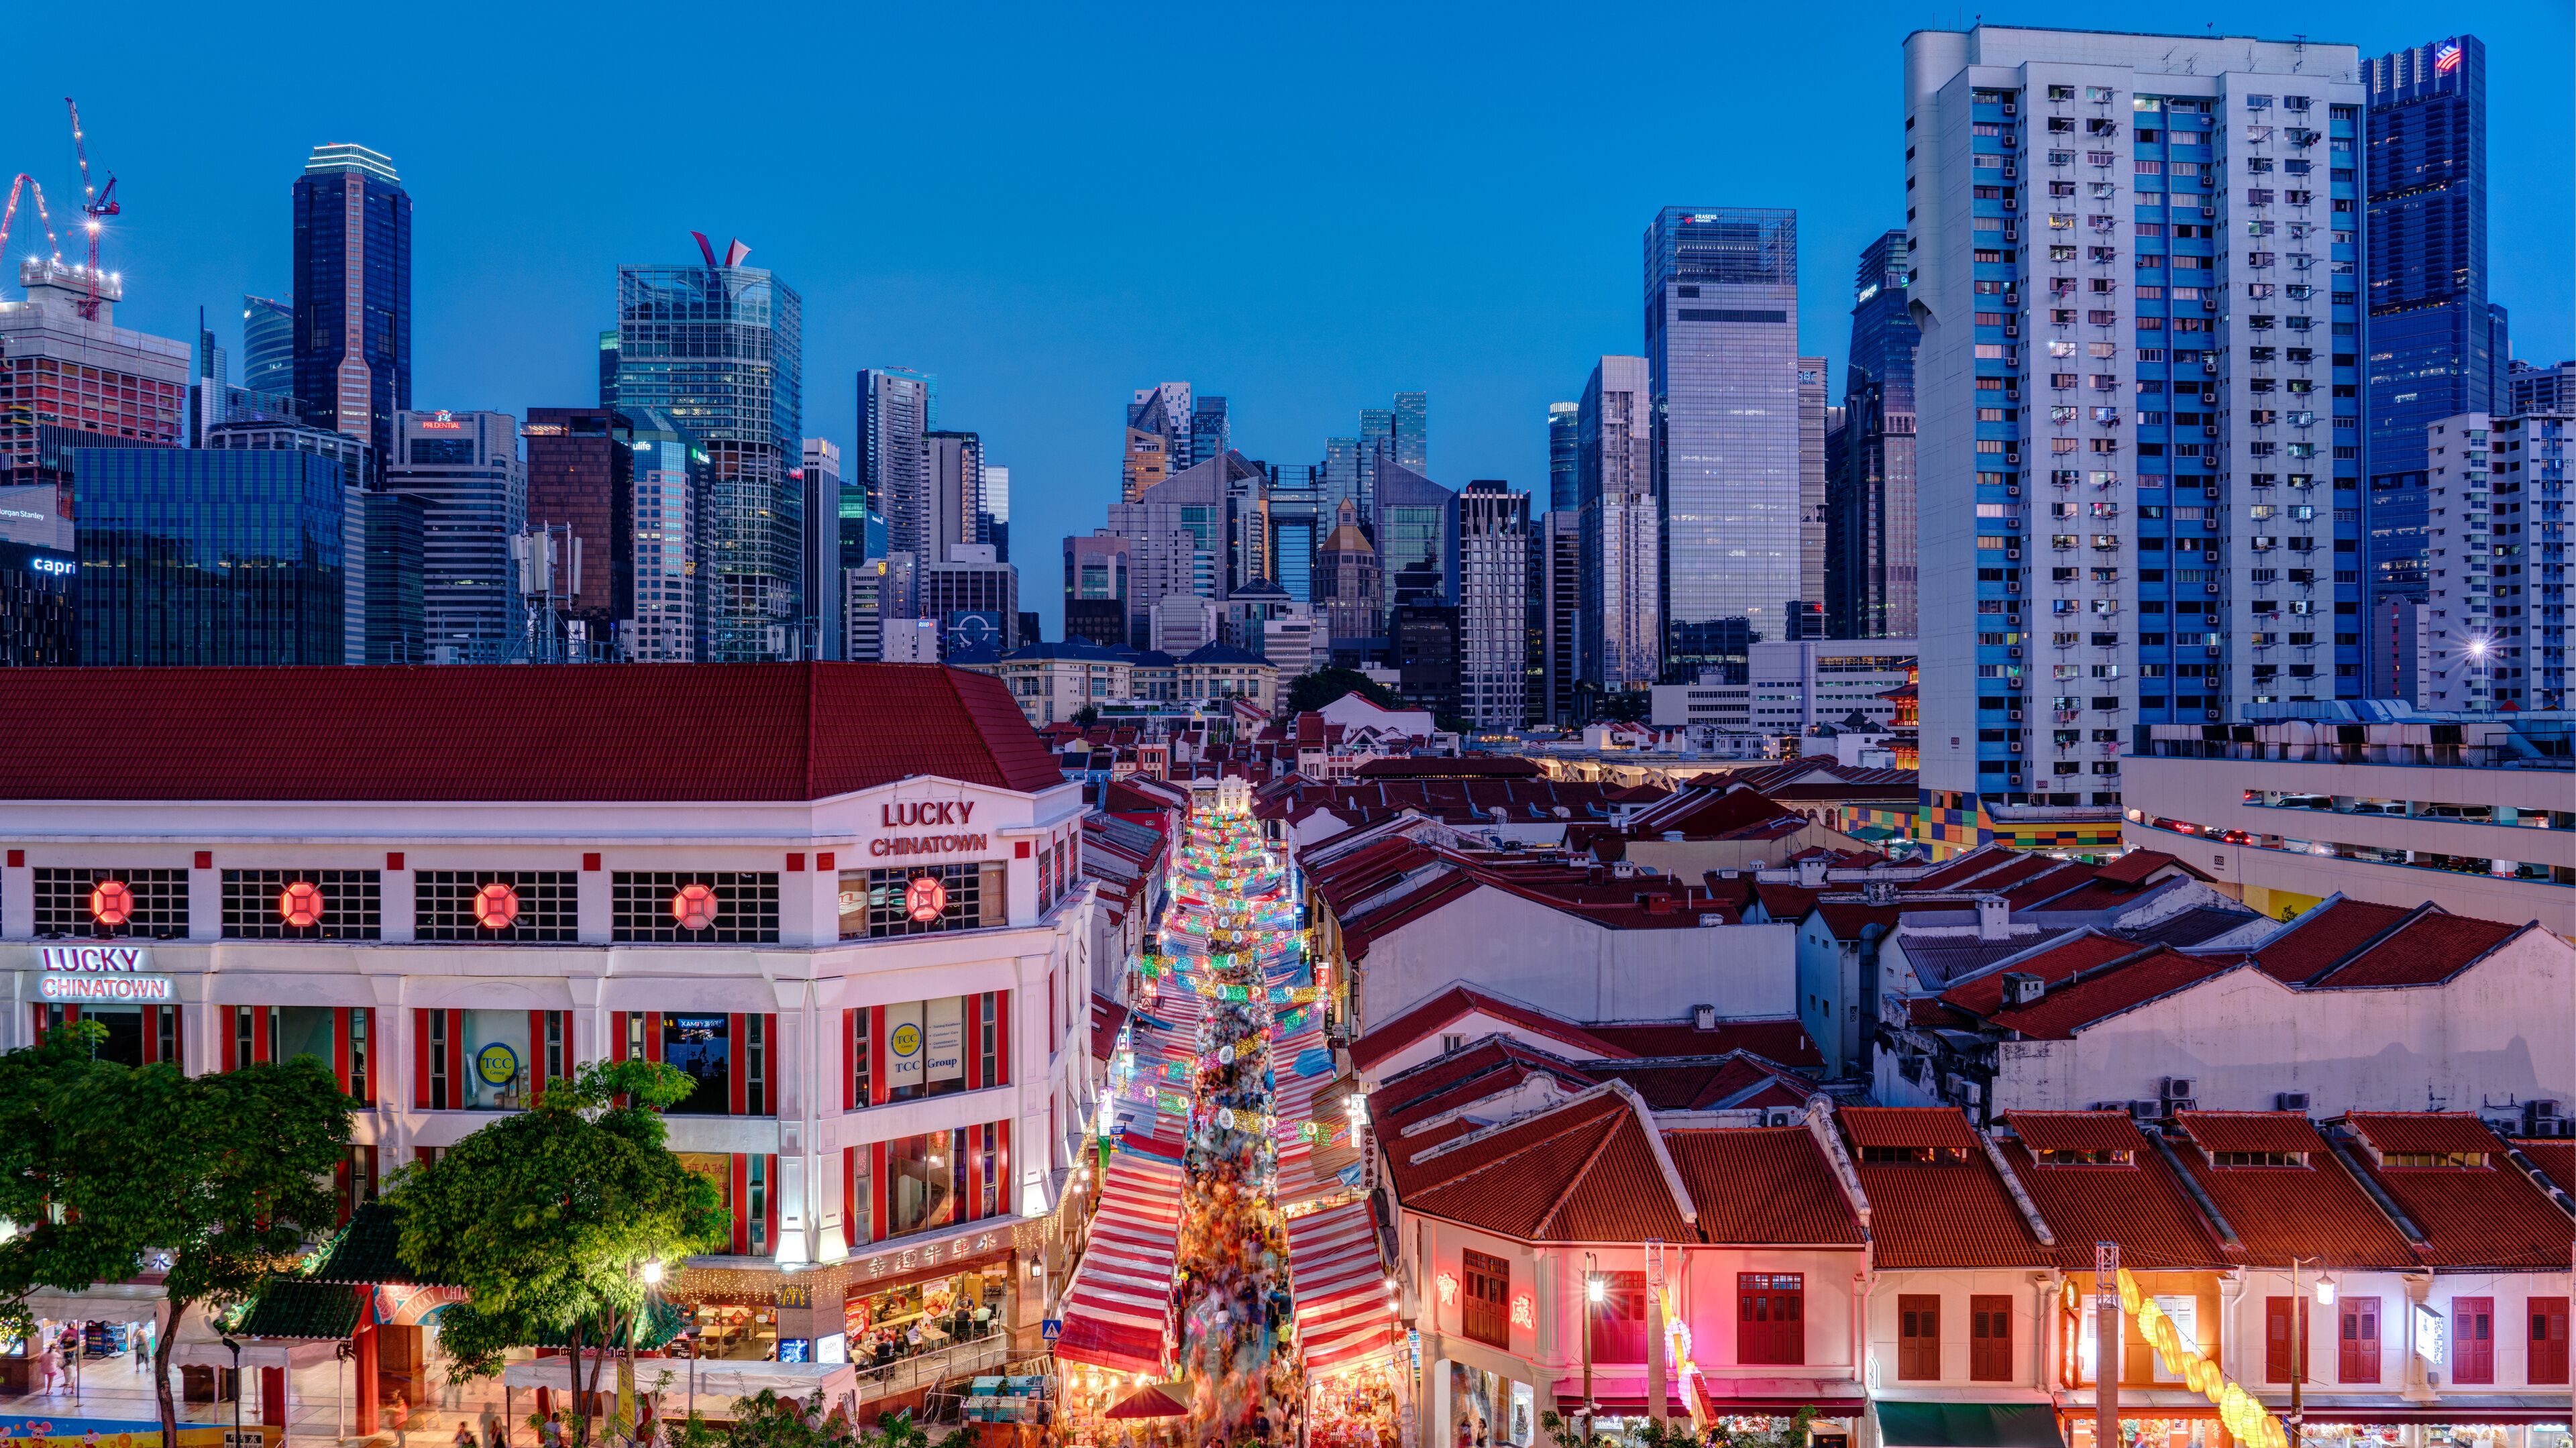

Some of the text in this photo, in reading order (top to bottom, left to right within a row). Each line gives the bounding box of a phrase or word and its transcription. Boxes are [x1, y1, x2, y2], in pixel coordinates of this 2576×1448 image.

[20, 510, 44, 520] Stanley
[34, 559, 76, 575] capri
[882, 801, 975, 828] LUCKY
[870, 834, 987, 857] CHINATOWN
[43, 948, 140, 972] LUCKY
[42, 979, 166, 998] CHINATOWN
[896, 1034, 917, 1044] TCC
[482, 1058, 512, 1069] TCC
[896, 1058, 957, 1073] TCC Group
[869, 1233, 996, 1279] 幸運牛車水
[404, 1289, 437, 1319] LUCKY
[1511, 1296, 1532, 1329] 成
